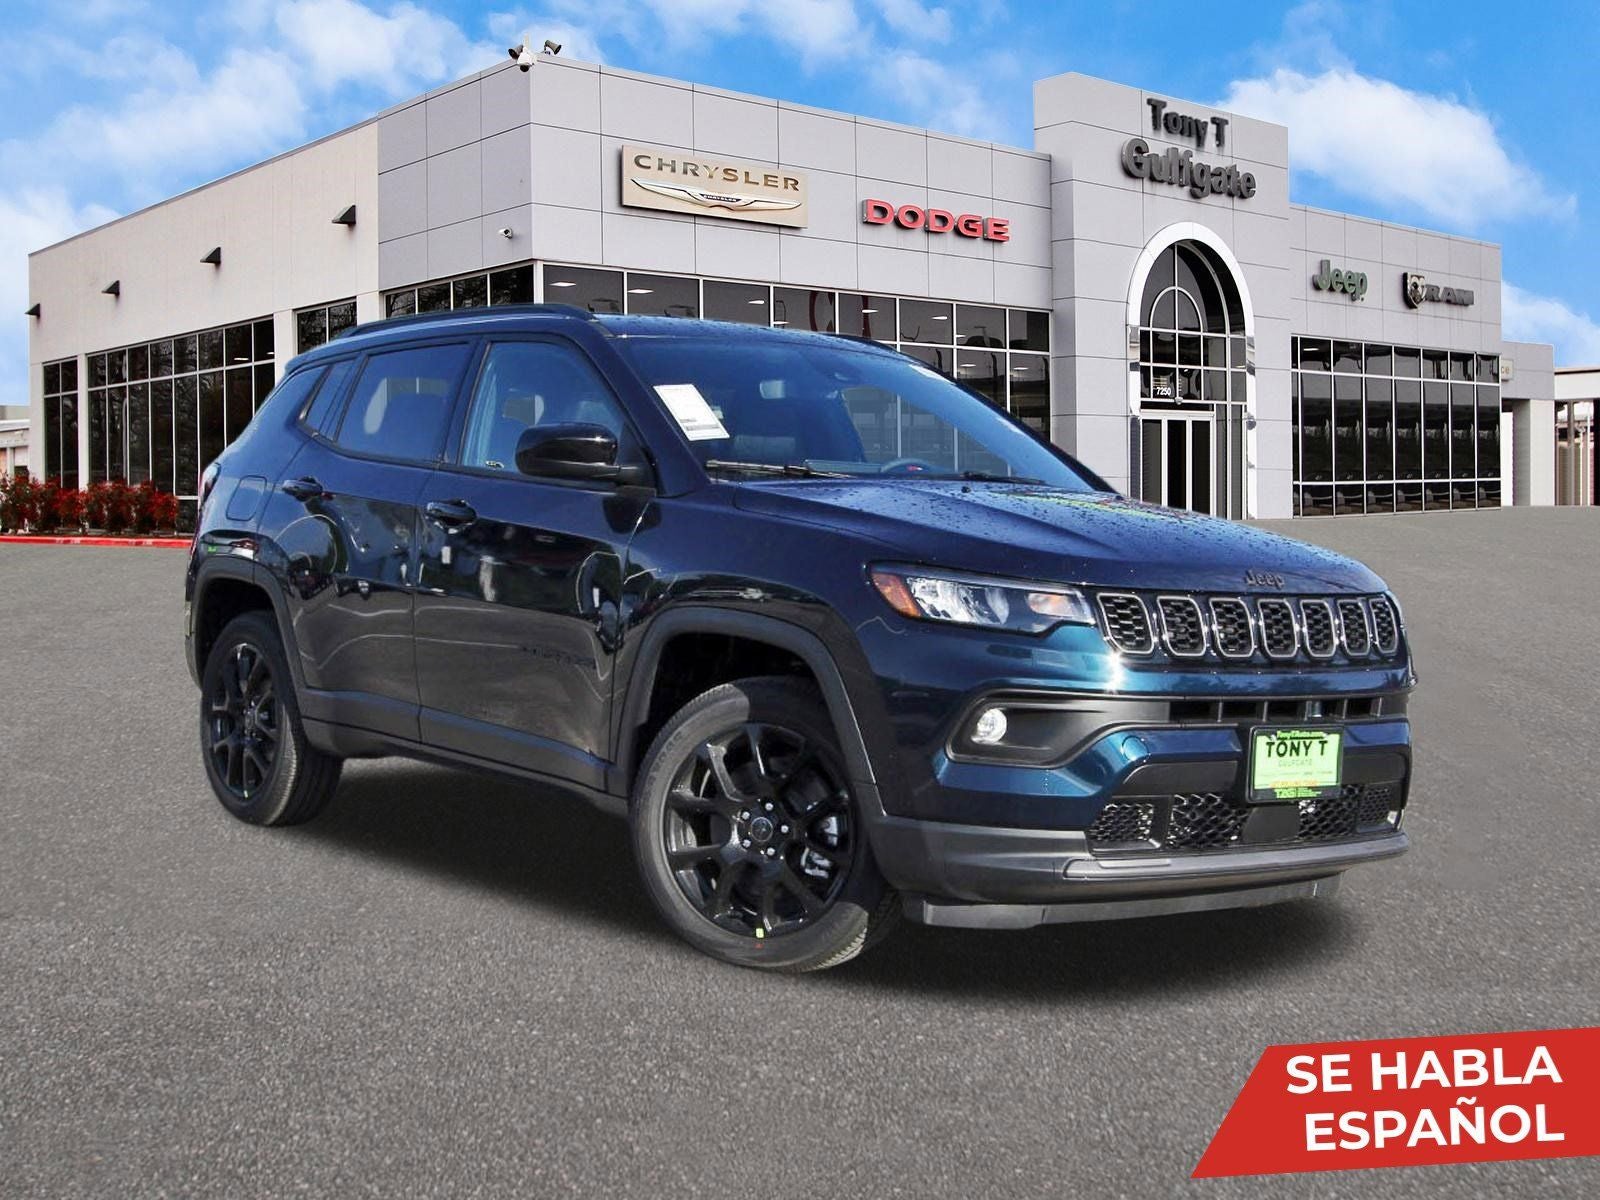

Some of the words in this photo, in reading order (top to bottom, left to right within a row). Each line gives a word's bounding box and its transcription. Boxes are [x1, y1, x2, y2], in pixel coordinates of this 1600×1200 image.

[1146, 98, 1208, 148] Tony
[1210, 116, 1229, 148] T
[633, 154, 800, 192] CHRYSLER
[1121, 138, 1257, 199] Gulfgate
[862, 199, 1010, 243] DODGE
[1312, 259, 1368, 302] Jeep
[1425, 284, 1475, 306] RAM
[1156, 386, 1172, 396] 7250
[1243, 570, 1285, 591] Jeep
[1265, 740, 1313, 758] TONY
[1318, 739, 1329, 756] T
